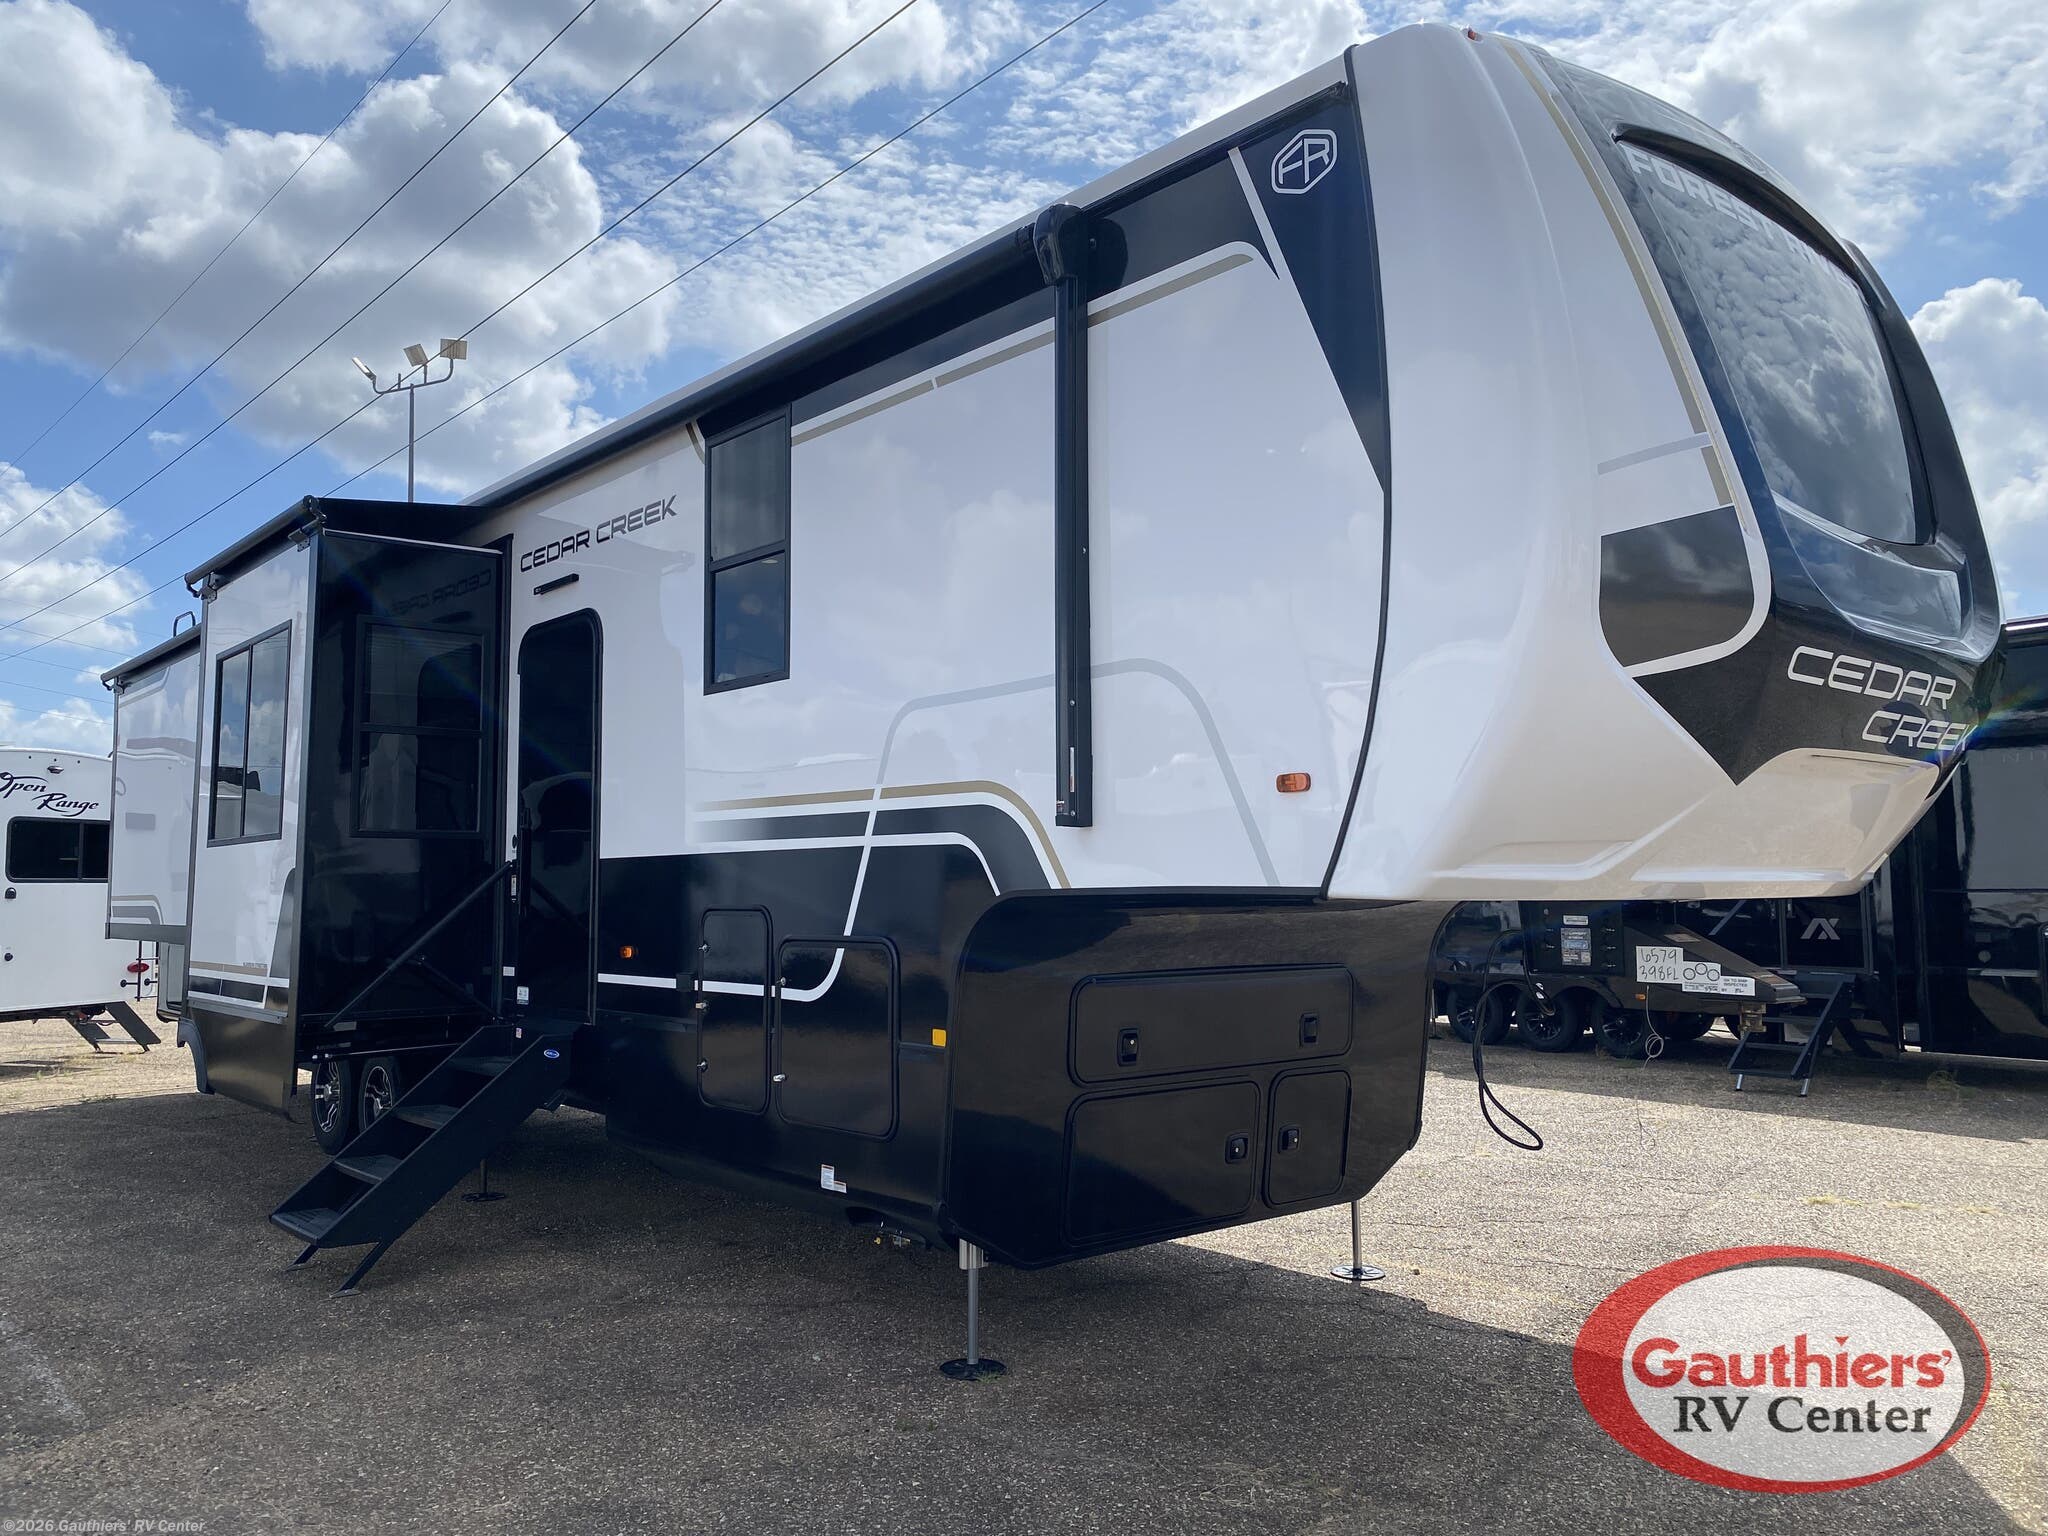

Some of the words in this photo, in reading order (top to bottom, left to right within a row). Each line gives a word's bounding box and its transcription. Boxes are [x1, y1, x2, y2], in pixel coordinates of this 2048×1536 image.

[1624, 147, 1779, 240] FOREST
[520, 529, 590, 573] CEDAR
[596, 494, 677, 543] CREEK
[1787, 645, 1957, 710] CEDAR
[31, 793, 99, 817] Range
[1638, 965, 1680, 981] 398FL
[1640, 947, 1678, 965] 6579
